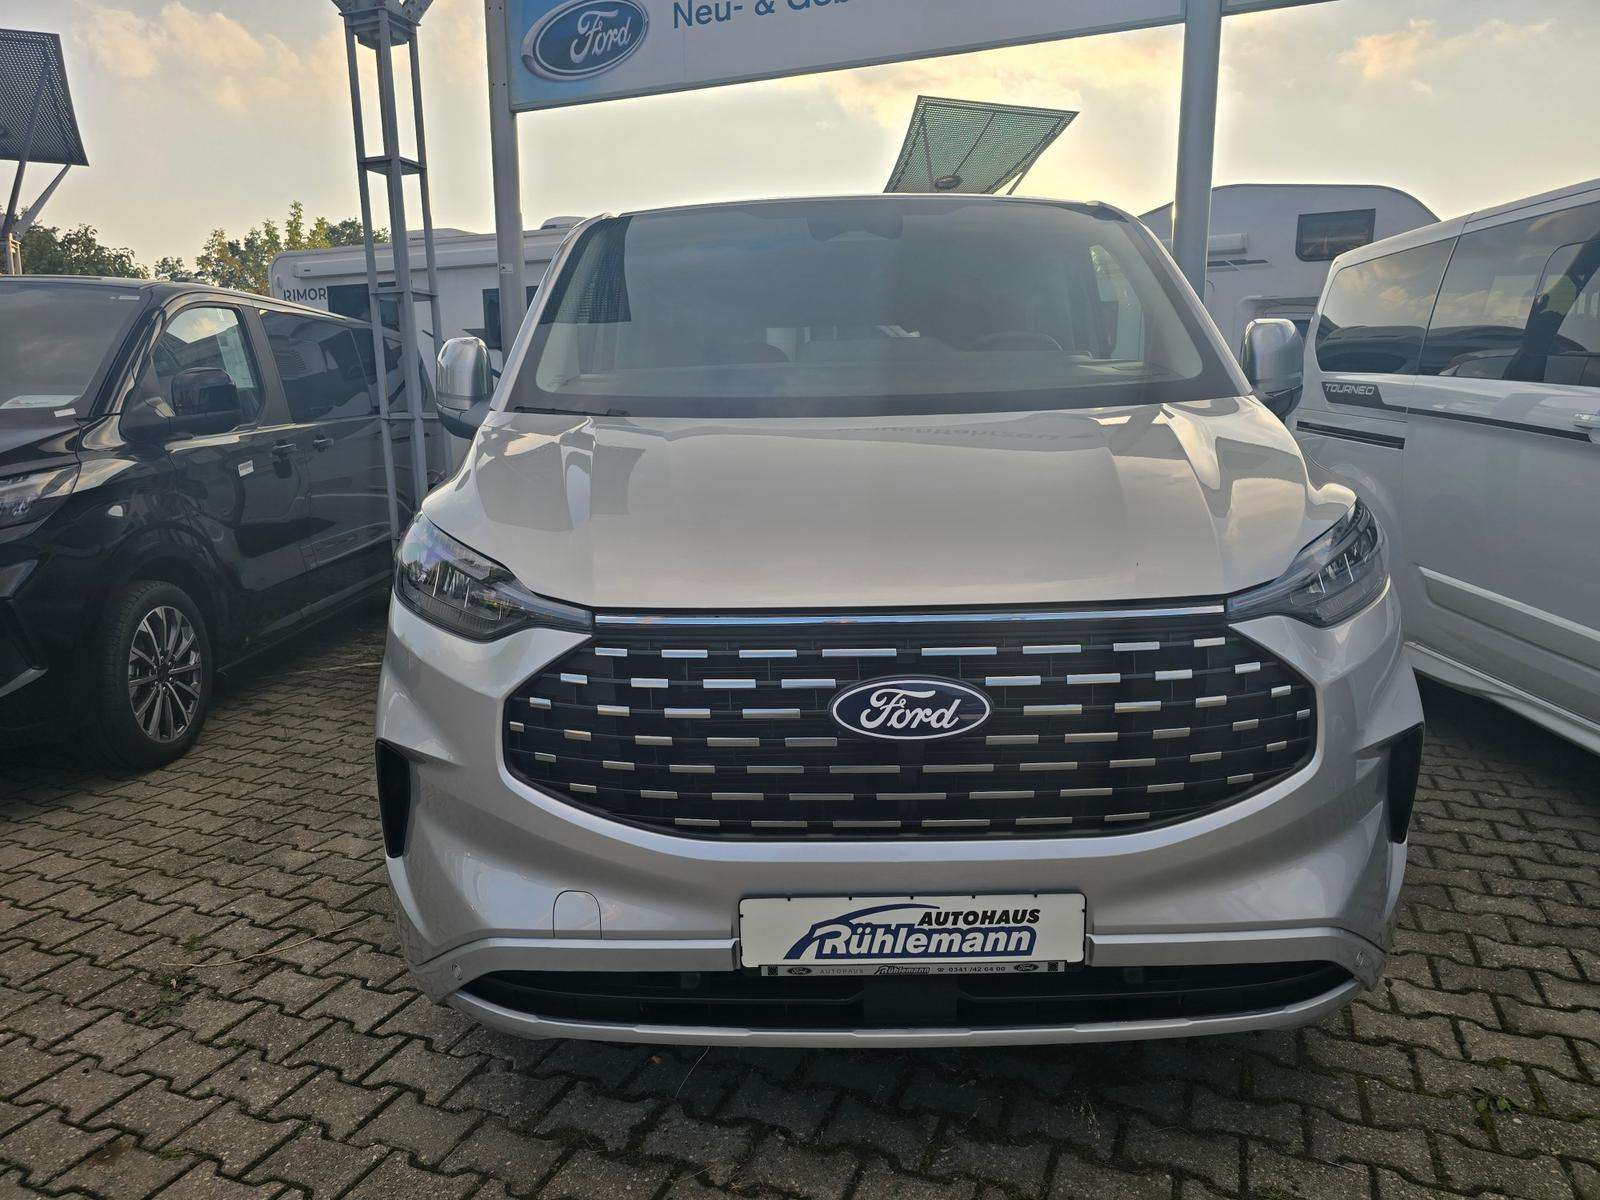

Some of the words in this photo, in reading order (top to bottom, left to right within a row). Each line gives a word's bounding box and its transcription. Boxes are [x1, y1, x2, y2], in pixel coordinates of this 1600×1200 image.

[672, 0, 744, 29] Neu-
[569, 8, 632, 64] Ford
[283, 287, 327, 302] RIMOR
[1325, 383, 1375, 396] TOURNEO
[859, 688, 962, 729] Ford
[917, 908, 1041, 927] AUTOHAUS
[811, 923, 1032, 957] Rühlemann
